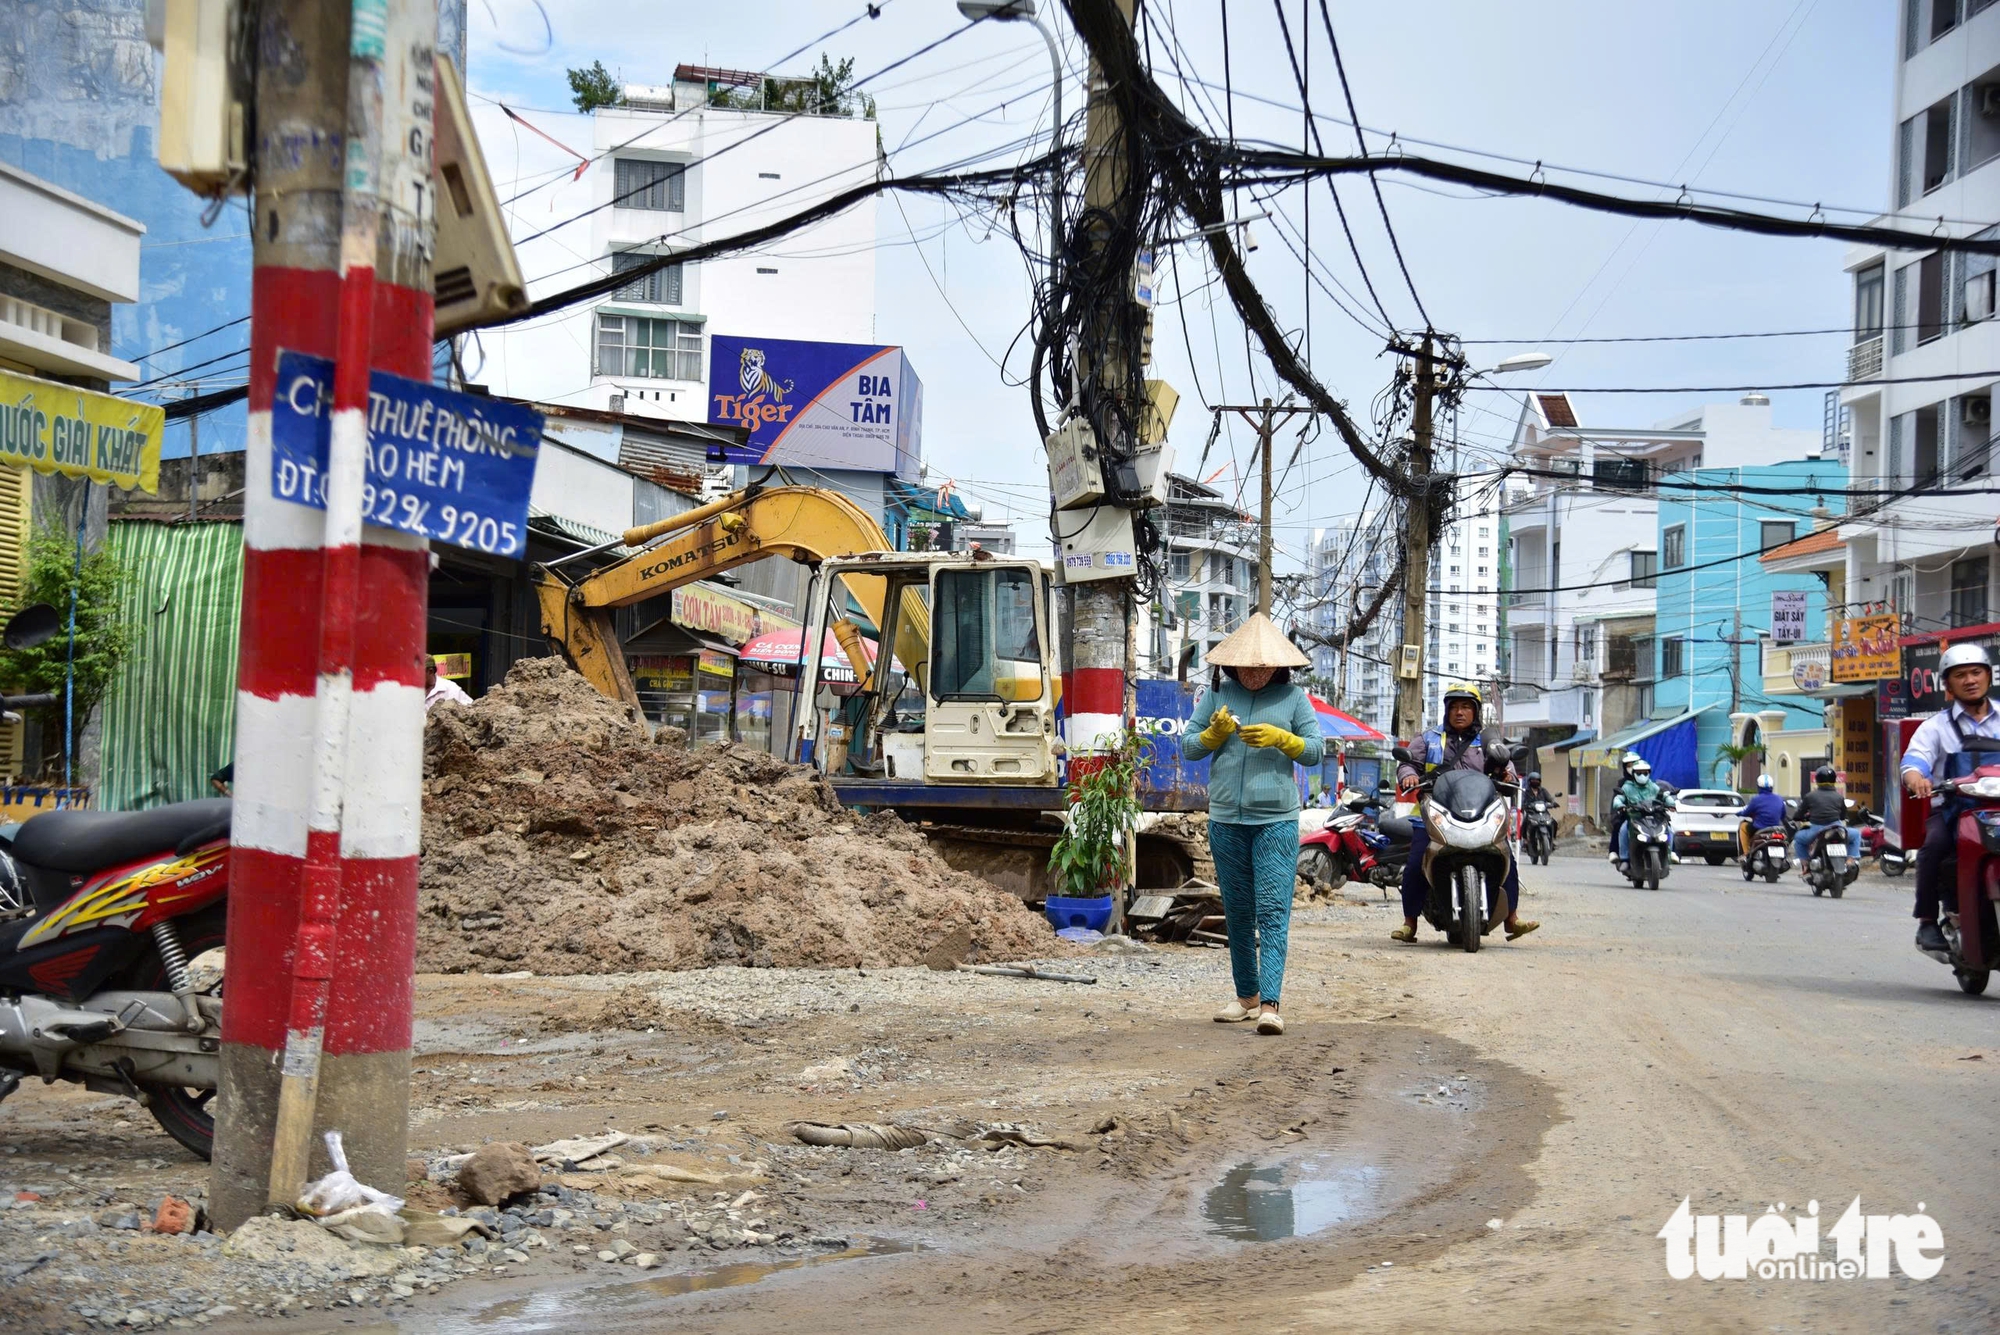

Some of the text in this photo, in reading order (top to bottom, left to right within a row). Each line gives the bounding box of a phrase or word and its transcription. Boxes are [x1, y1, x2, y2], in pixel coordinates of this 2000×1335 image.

[858, 375, 891, 397] BIA
[714, 394, 793, 433] Tiger
[850, 398, 891, 424] TÂM
[0, 393, 47, 460] ƯỚC
[96, 416, 148, 476] KHÁT
[640, 530, 740, 581] KOMATSU
[683, 592, 701, 626] CƠM
